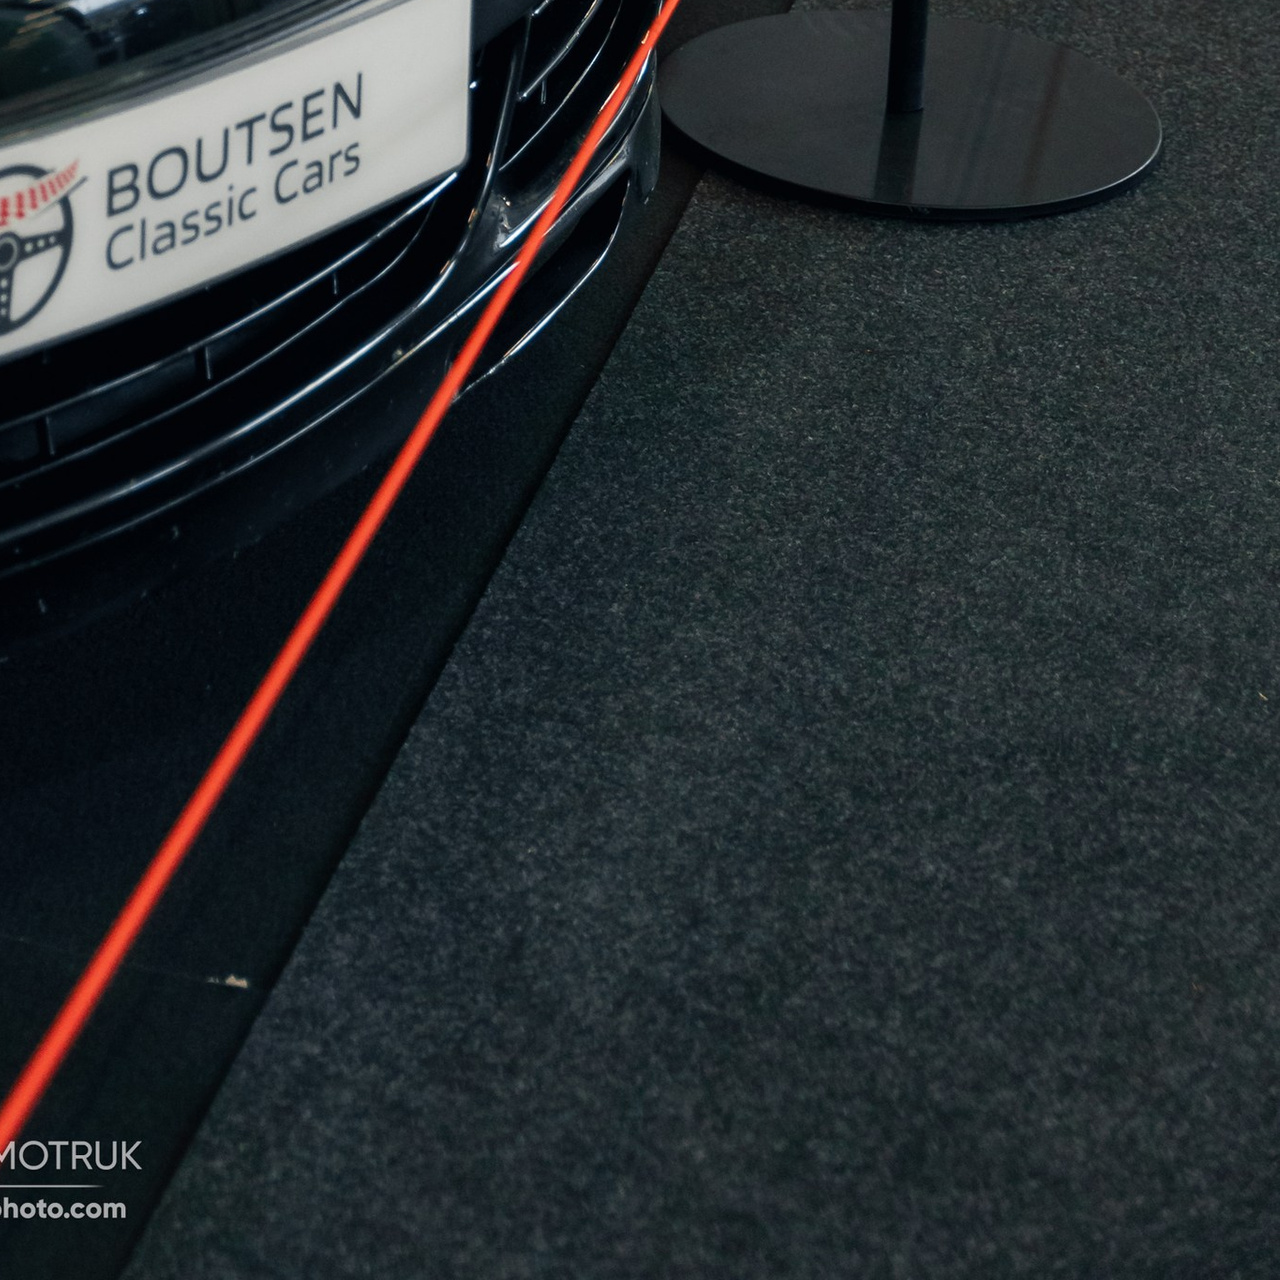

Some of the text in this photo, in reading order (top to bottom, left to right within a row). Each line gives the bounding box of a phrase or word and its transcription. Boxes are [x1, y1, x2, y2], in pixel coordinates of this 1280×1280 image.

[105, 142, 360, 271] Classic Cars
[107, 72, 363, 217] BOUTSEN
